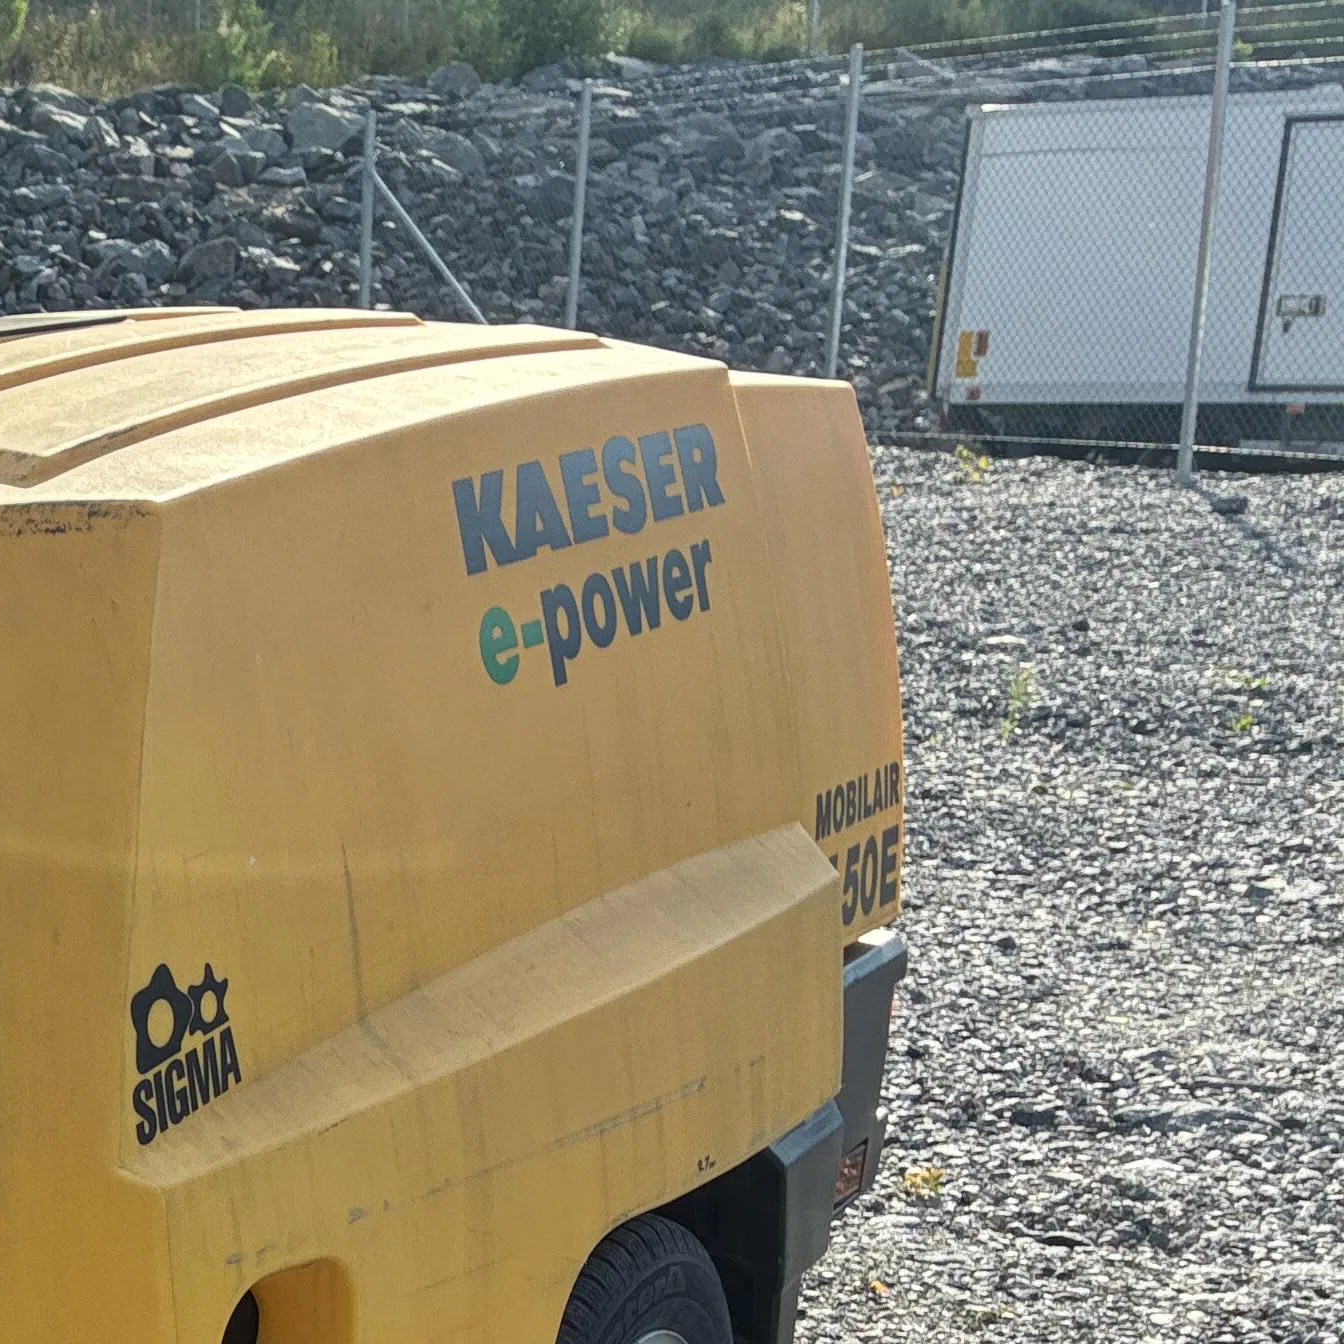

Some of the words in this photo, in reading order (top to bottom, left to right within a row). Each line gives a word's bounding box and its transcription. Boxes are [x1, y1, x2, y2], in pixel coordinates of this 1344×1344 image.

[452, 423, 726, 576] KAESER
[479, 537, 712, 687] e-power
[815, 762, 901, 841] MOBILAIR
[133, 1026, 242, 1146] SIGMA
